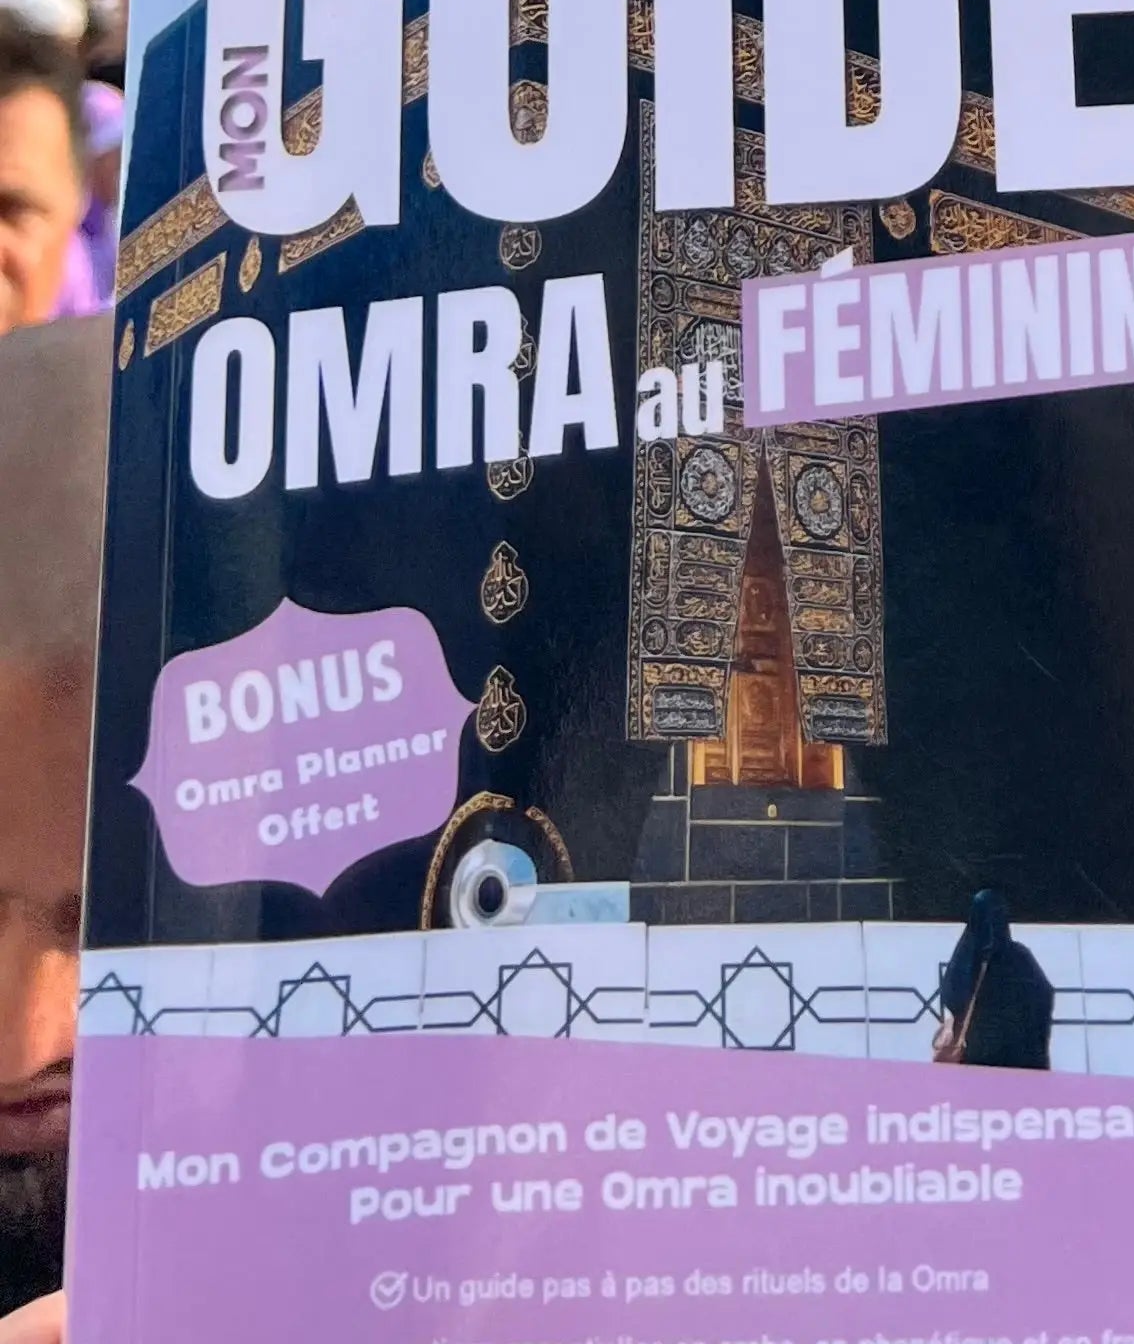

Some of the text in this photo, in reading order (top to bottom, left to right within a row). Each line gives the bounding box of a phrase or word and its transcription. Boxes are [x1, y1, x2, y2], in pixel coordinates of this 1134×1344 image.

[218, 44, 269, 193] MON
[189, 274, 620, 500] OMRA
[636, 360, 726, 441] au
[184, 640, 403, 744] BONUS
[175, 728, 447, 811] Omra Planner
[258, 793, 380, 846] Offert
[137, 1150, 241, 1191] Mon
[260, 1121, 568, 1174] Compagnon
[584, 1112, 647, 1152] de
[666, 1110, 849, 1159] Voyage
[350, 1162, 1024, 1225] pour une Omra inoubliable
[412, 1264, 991, 1307] Un guide pas à pas des rituels de la Omra
